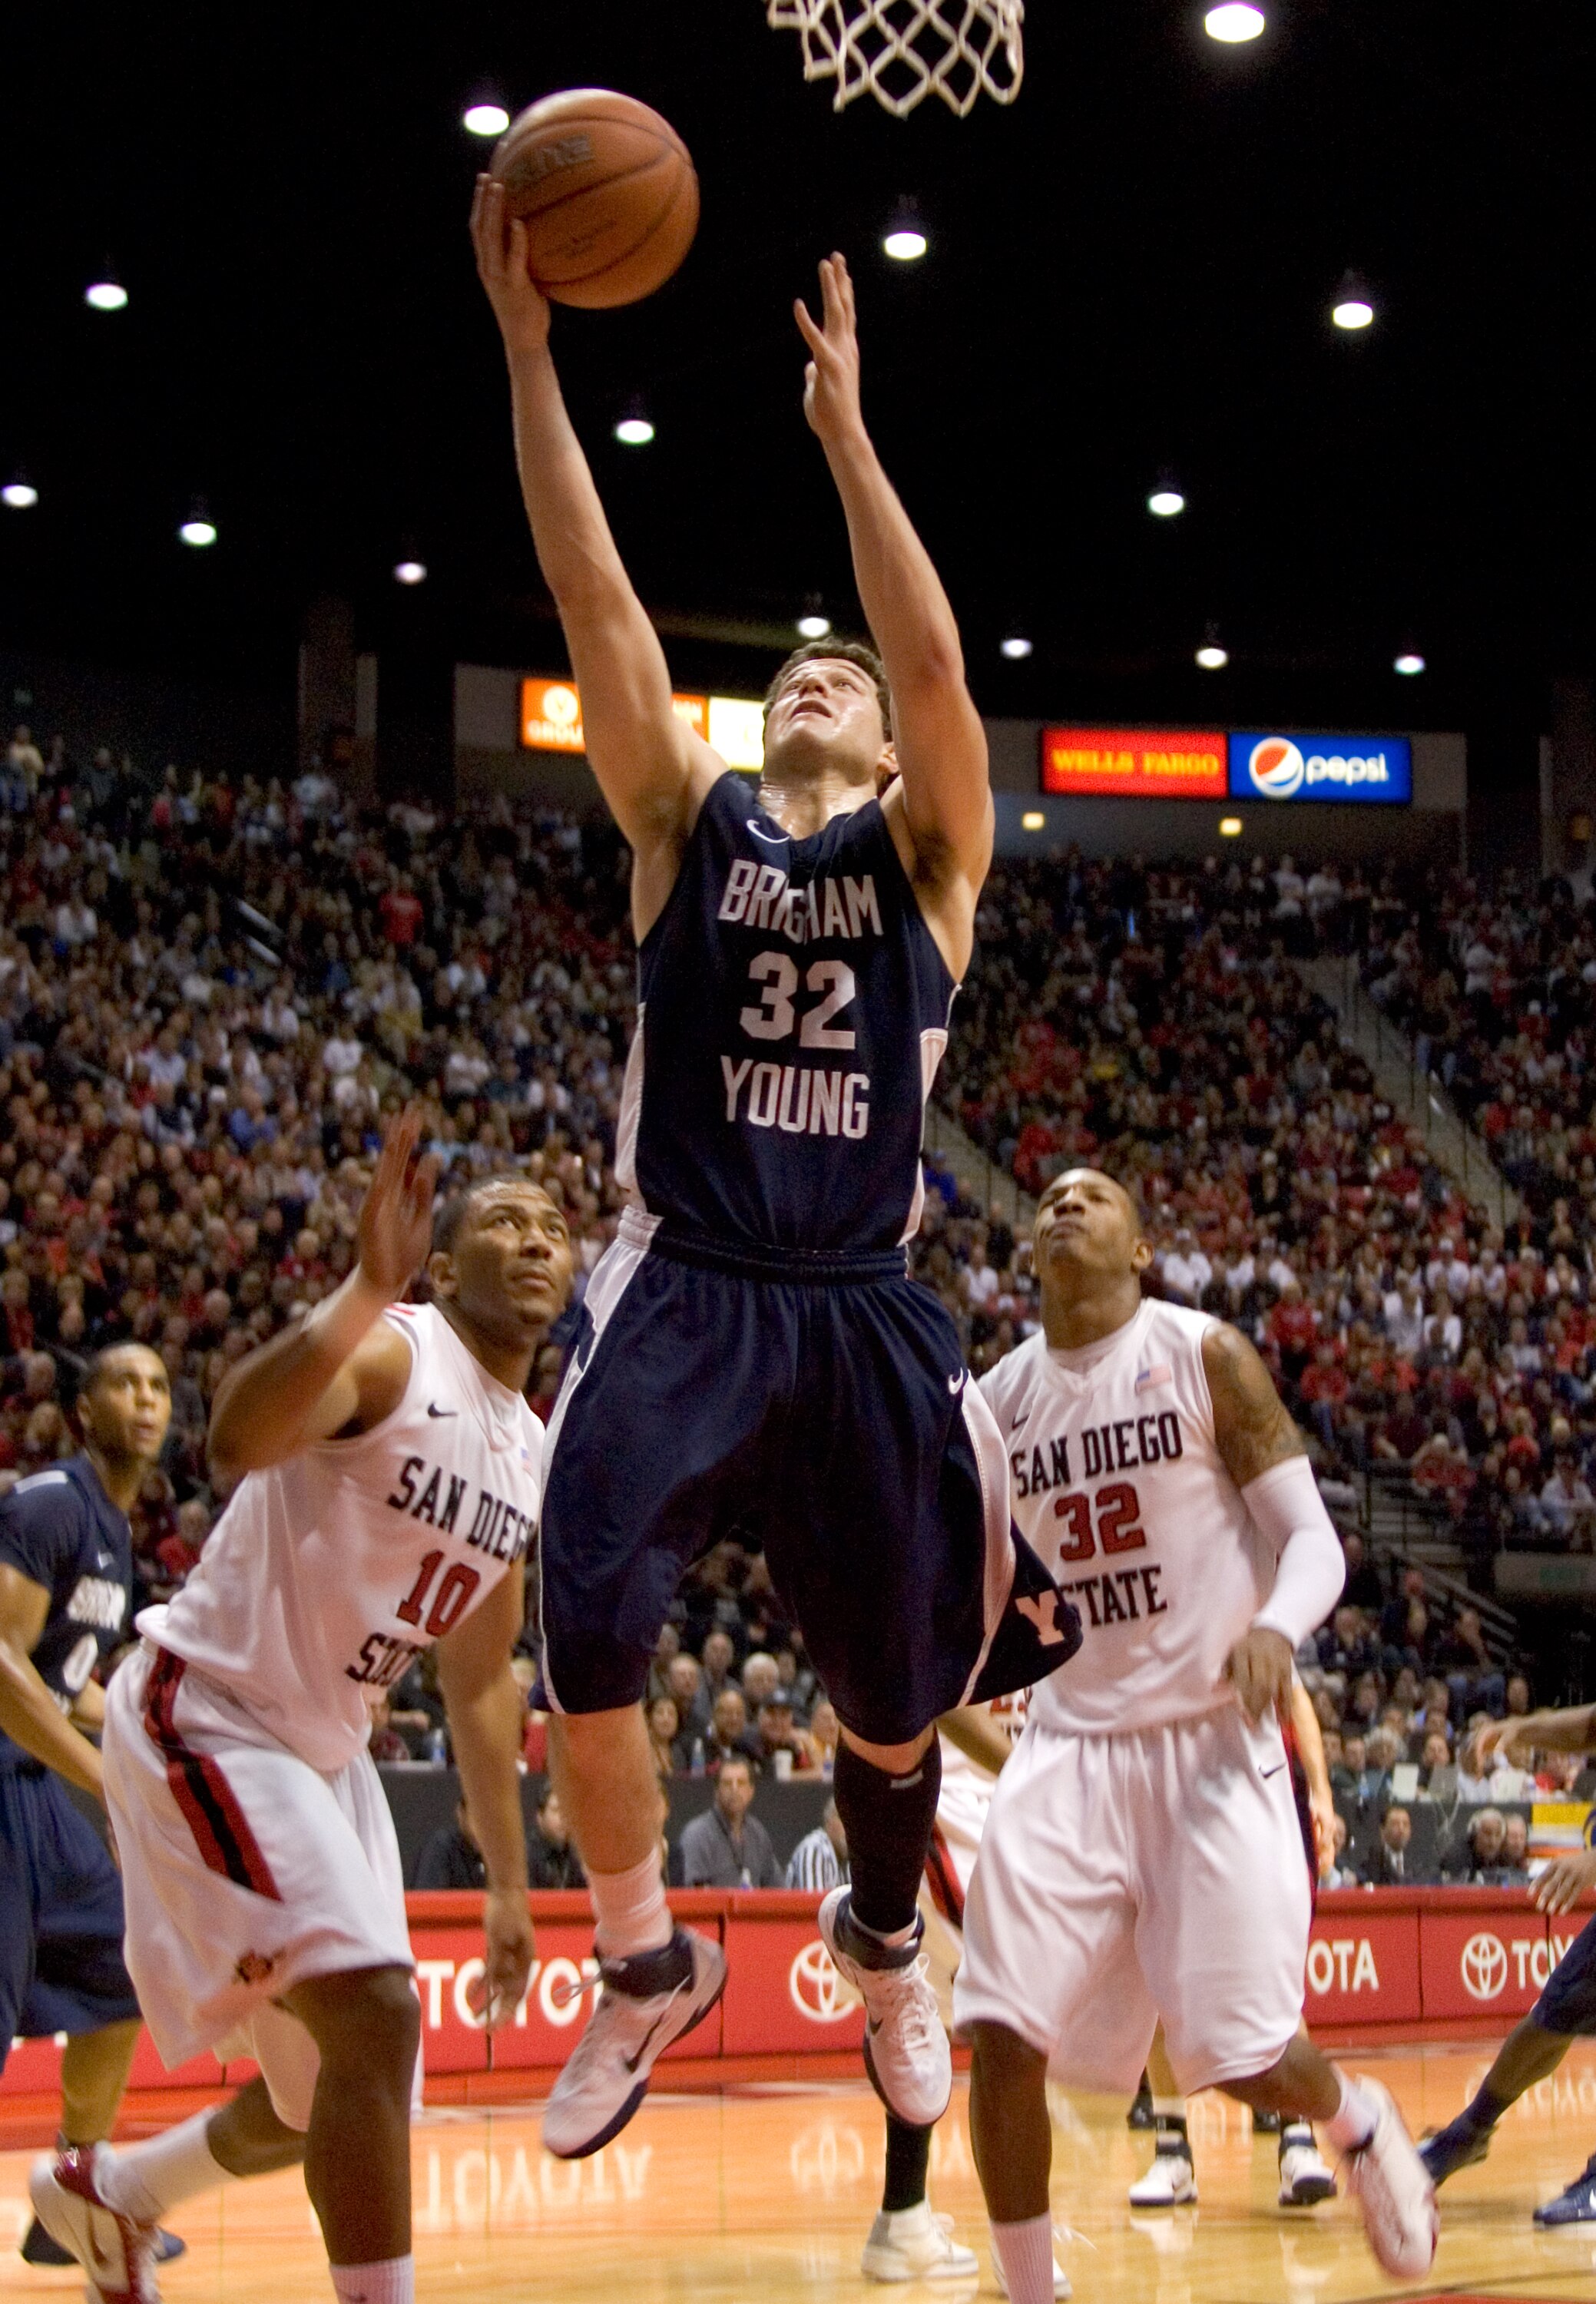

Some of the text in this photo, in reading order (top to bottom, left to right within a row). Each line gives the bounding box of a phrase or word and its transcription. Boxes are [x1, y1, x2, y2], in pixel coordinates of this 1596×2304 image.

[1306, 753, 1389, 786] pepsi
[739, 951, 856, 1050] 32
[720, 1055, 870, 1139] YOUNG
[388, 1457, 468, 1534] SAN
[1010, 1411, 1184, 1500] SAN DIEGO
[1054, 1481, 1147, 1562] 32
[396, 1548, 481, 1637] 10
[1015, 1589, 1065, 1647] Y
